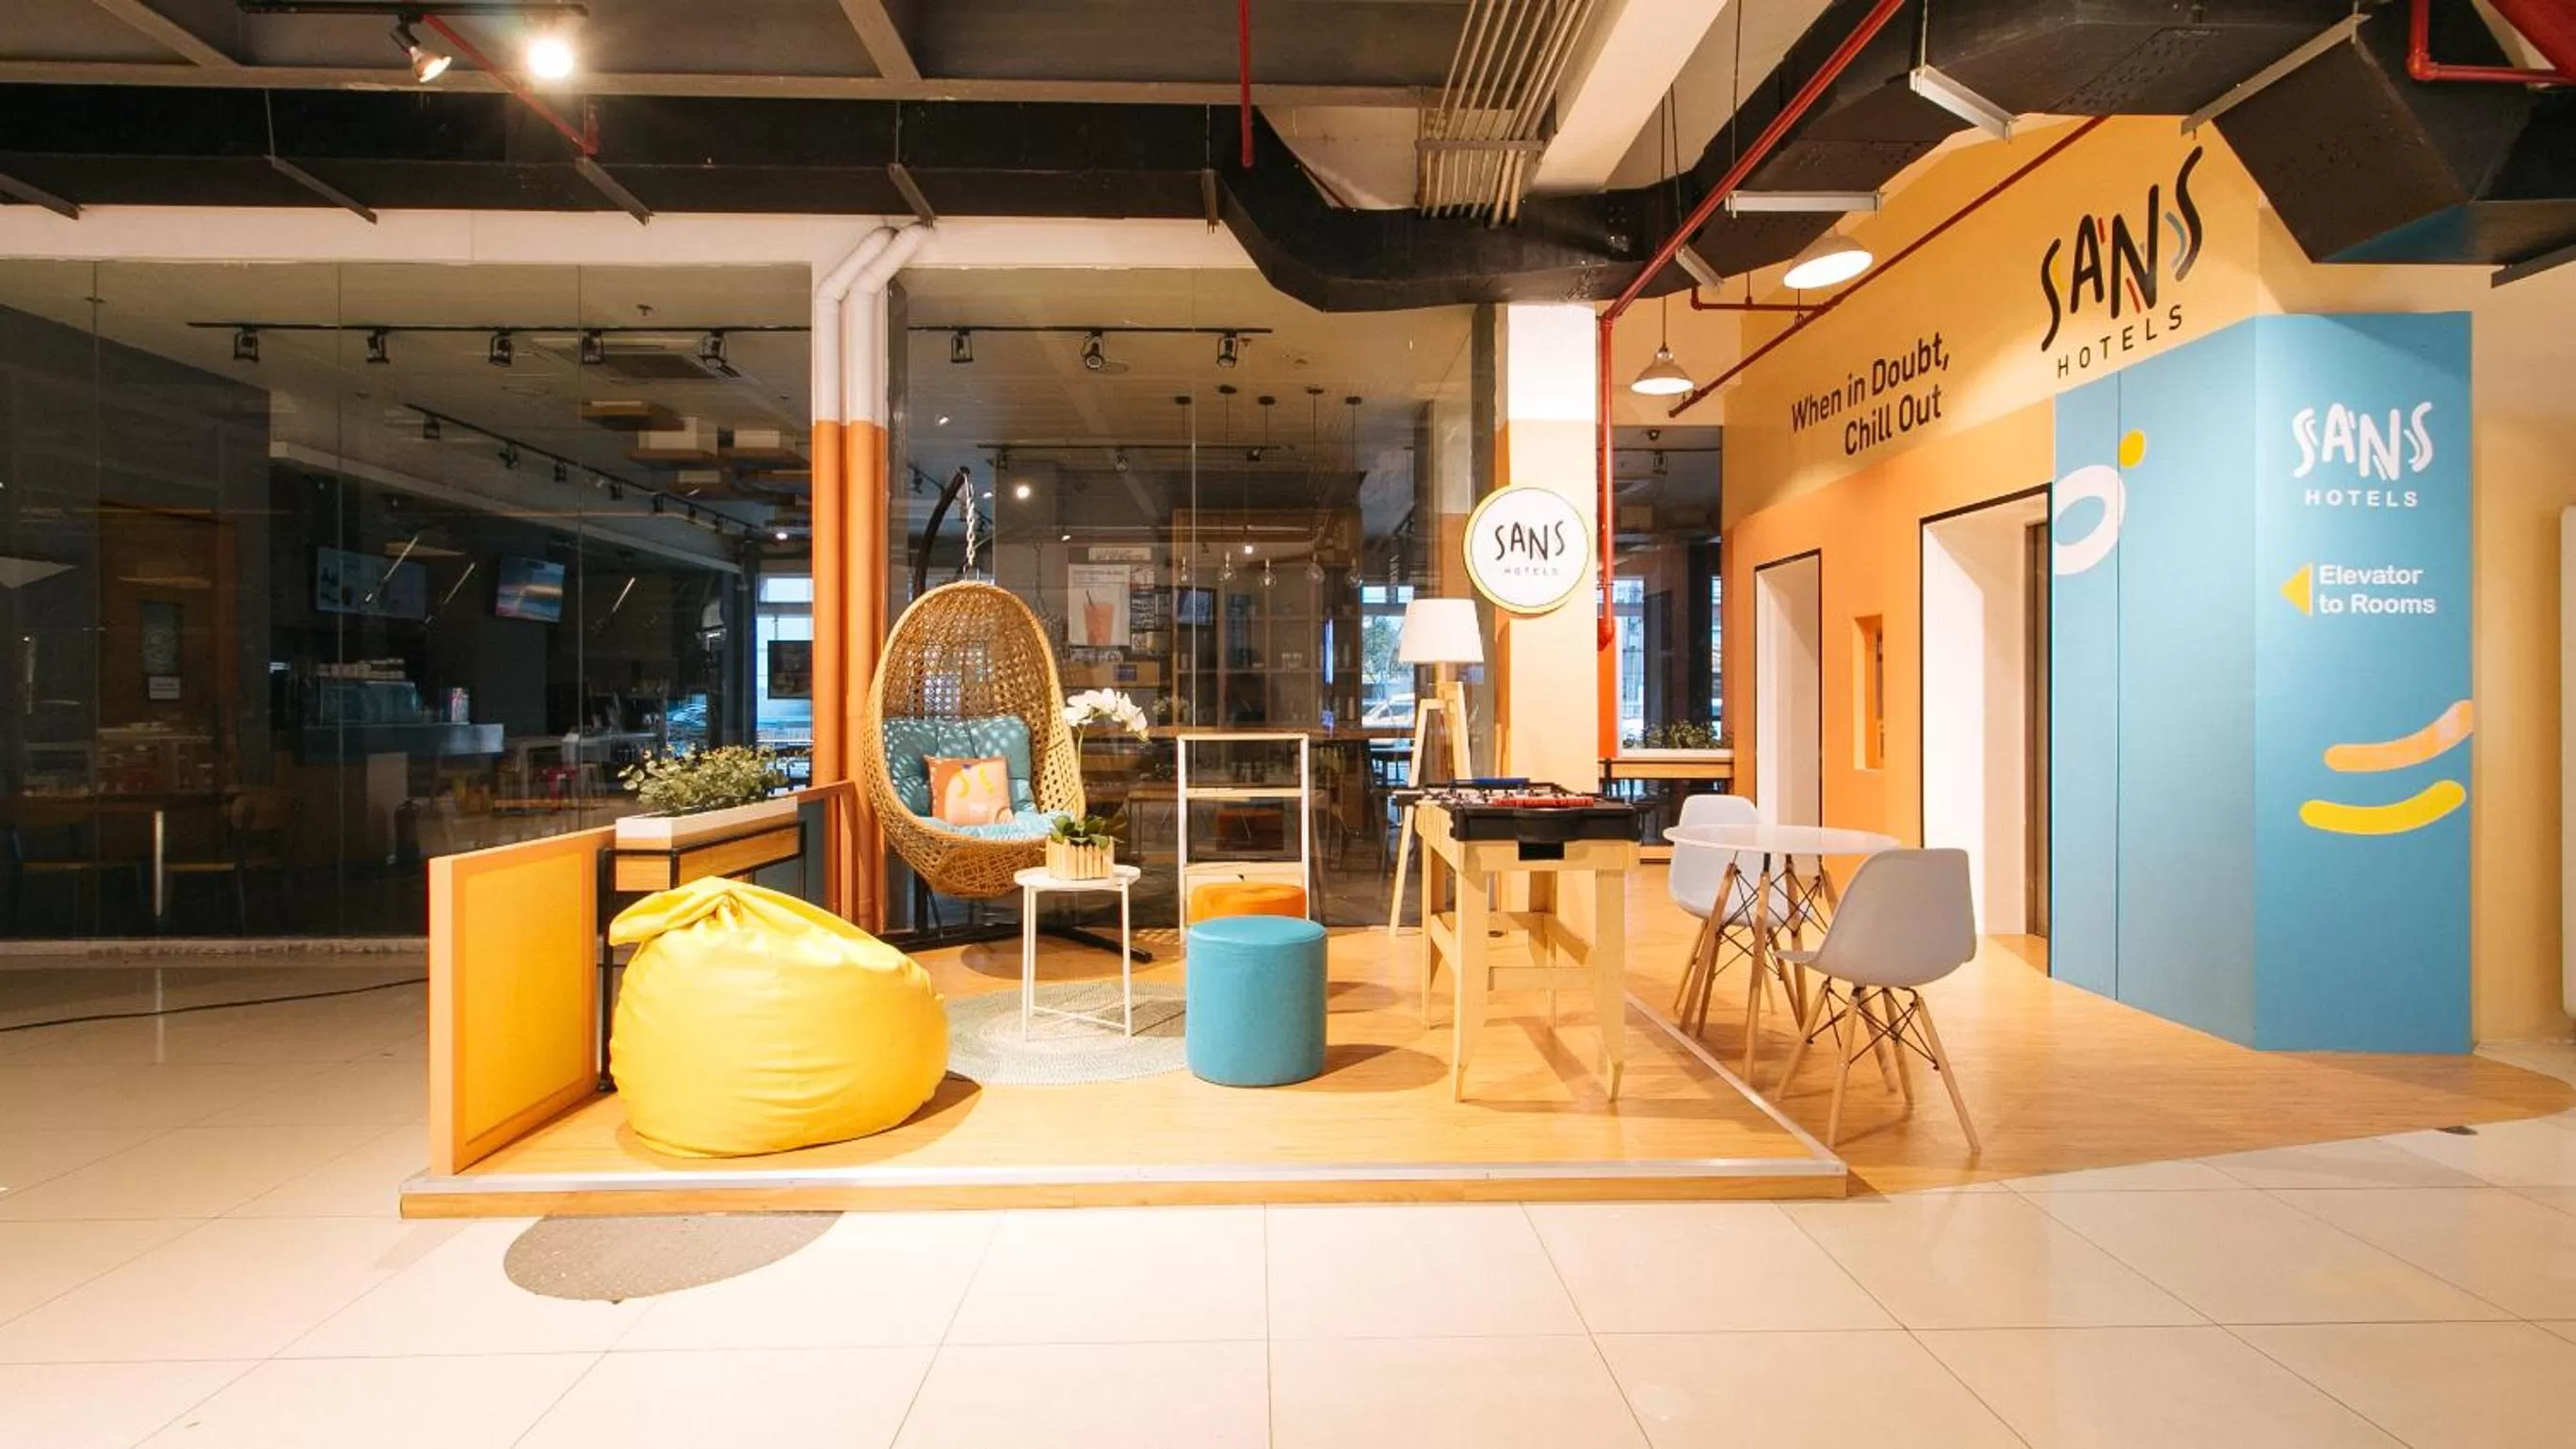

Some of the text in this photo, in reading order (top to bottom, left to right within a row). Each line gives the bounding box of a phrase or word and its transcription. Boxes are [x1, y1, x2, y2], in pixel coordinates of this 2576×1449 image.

[2040, 146, 2203, 352] SANS
[2057, 304, 2182, 379] HOTELS
[1792, 331, 1950, 433] When in Doubt,
[1845, 384, 1941, 456] Chill Out
[2292, 401, 2434, 481] SANS
[2305, 490, 2419, 507] HOTELS
[1494, 520, 1565, 561] SANS
[1504, 567, 1560, 576] HOTELS
[2319, 565, 2423, 585] Elevator
[2319, 594, 2437, 614] to Rooms
